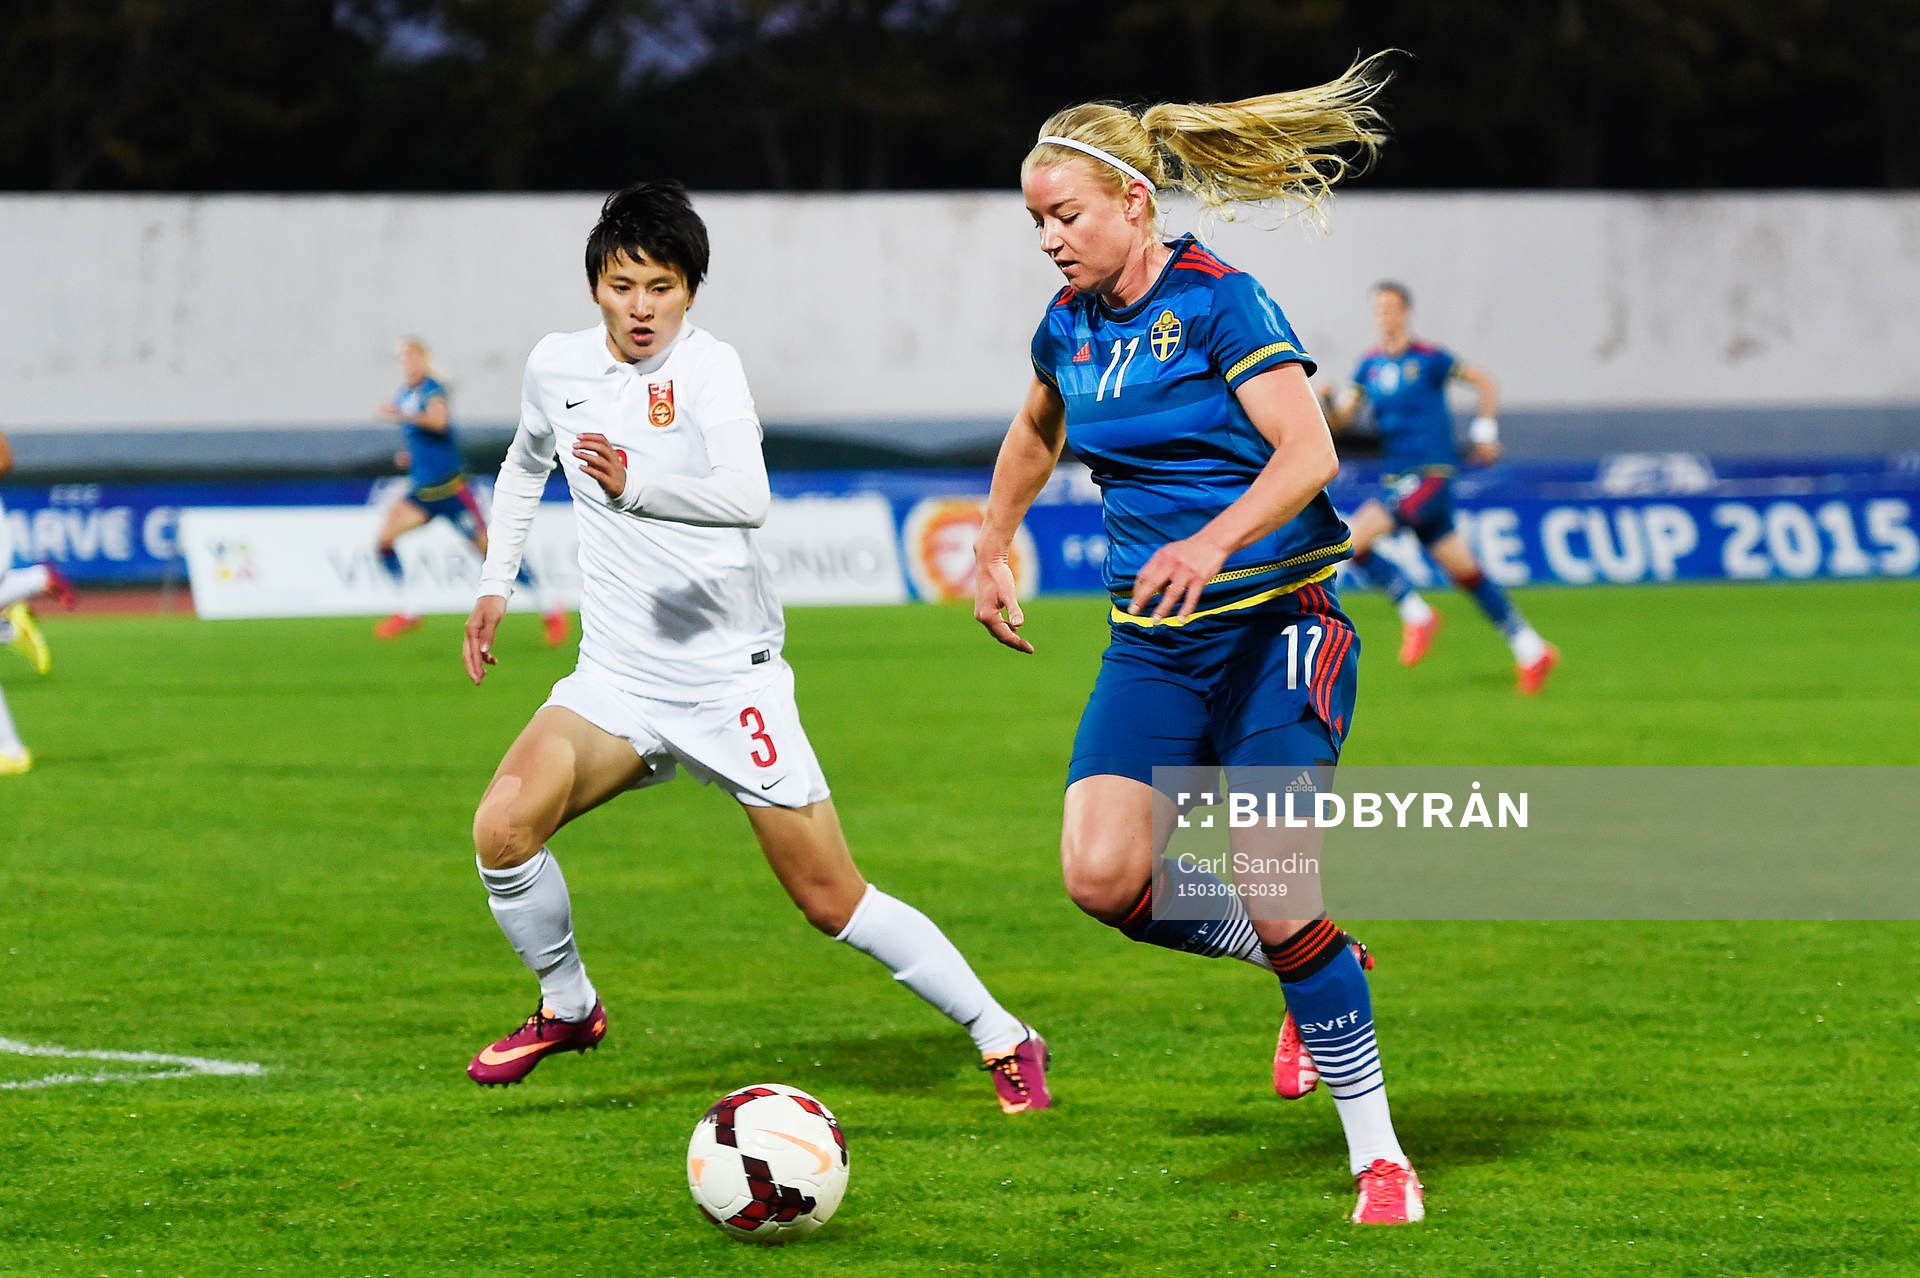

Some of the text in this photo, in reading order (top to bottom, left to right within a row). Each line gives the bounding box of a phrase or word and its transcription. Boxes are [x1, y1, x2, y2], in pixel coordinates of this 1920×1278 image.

[1096, 337, 1140, 402] 11
[1539, 506, 1699, 585] CUP
[1713, 498, 1919, 579] 2015
[1281, 624, 1323, 691] 11
[739, 706, 778, 769] 3
[1285, 784, 1317, 792] adidas
[1300, 1010, 1358, 1033] SVFF
